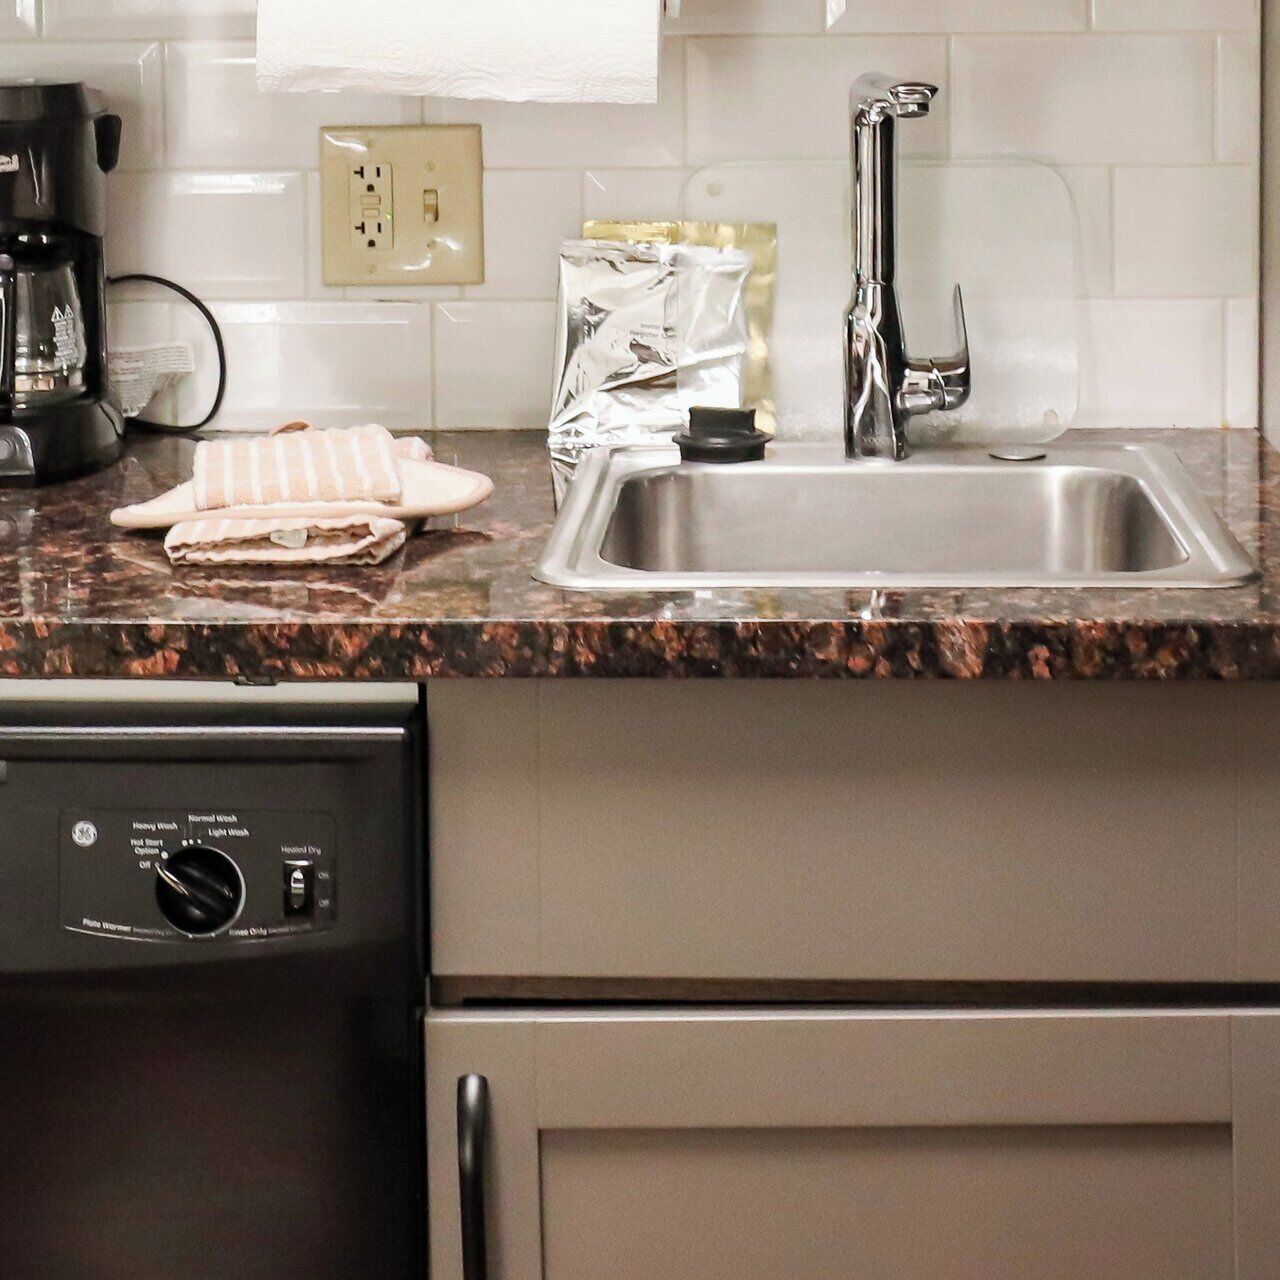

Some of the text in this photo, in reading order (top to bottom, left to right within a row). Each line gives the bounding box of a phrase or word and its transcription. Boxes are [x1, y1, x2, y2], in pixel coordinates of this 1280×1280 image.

[188, 814, 238, 823] Normal Wash
[132, 822, 178, 831] Heavy Wash
[208, 828, 250, 838] Light Wash
[145, 839, 164, 847] Start
[134, 847, 159, 856] Option
[281, 846, 321, 855] Heated Dry
[139, 860, 151, 870] Off
